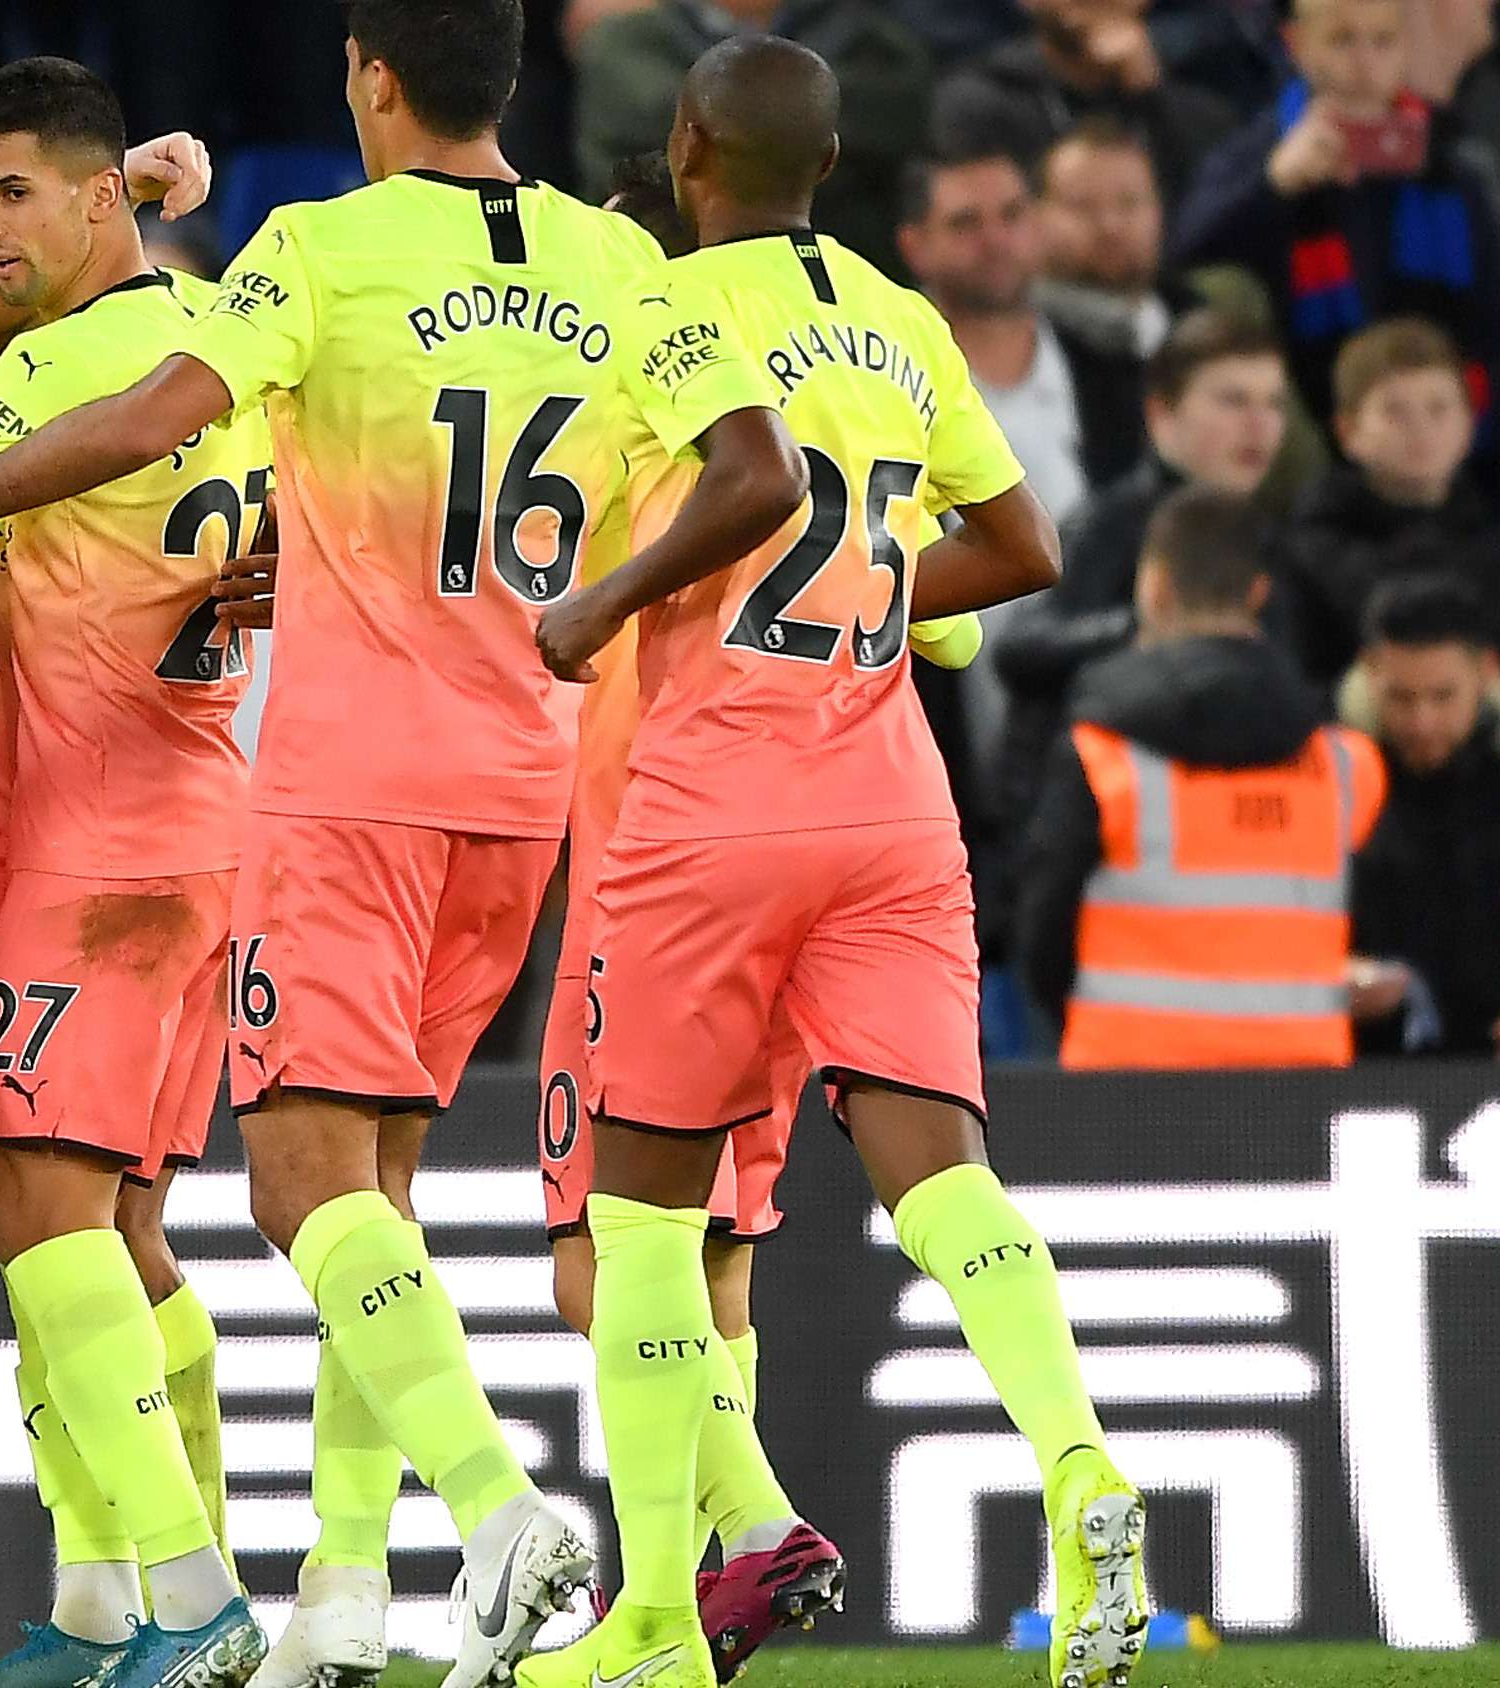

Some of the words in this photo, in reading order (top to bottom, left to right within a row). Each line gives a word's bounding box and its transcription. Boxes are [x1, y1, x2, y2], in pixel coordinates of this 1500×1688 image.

[485, 199, 513, 214] CITY
[408, 285, 611, 363] RODRIGO
[642, 322, 720, 384] NEXEN
[658, 344, 719, 389] TIRE
[434, 388, 585, 603] 16
[722, 446, 925, 669] 25
[228, 936, 278, 1029] 16
[963, 1243, 1032, 1278] CITY
[361, 1269, 422, 1316] CITY
[638, 1336, 708, 1359] CITY
[135, 1390, 173, 1415] CIT
